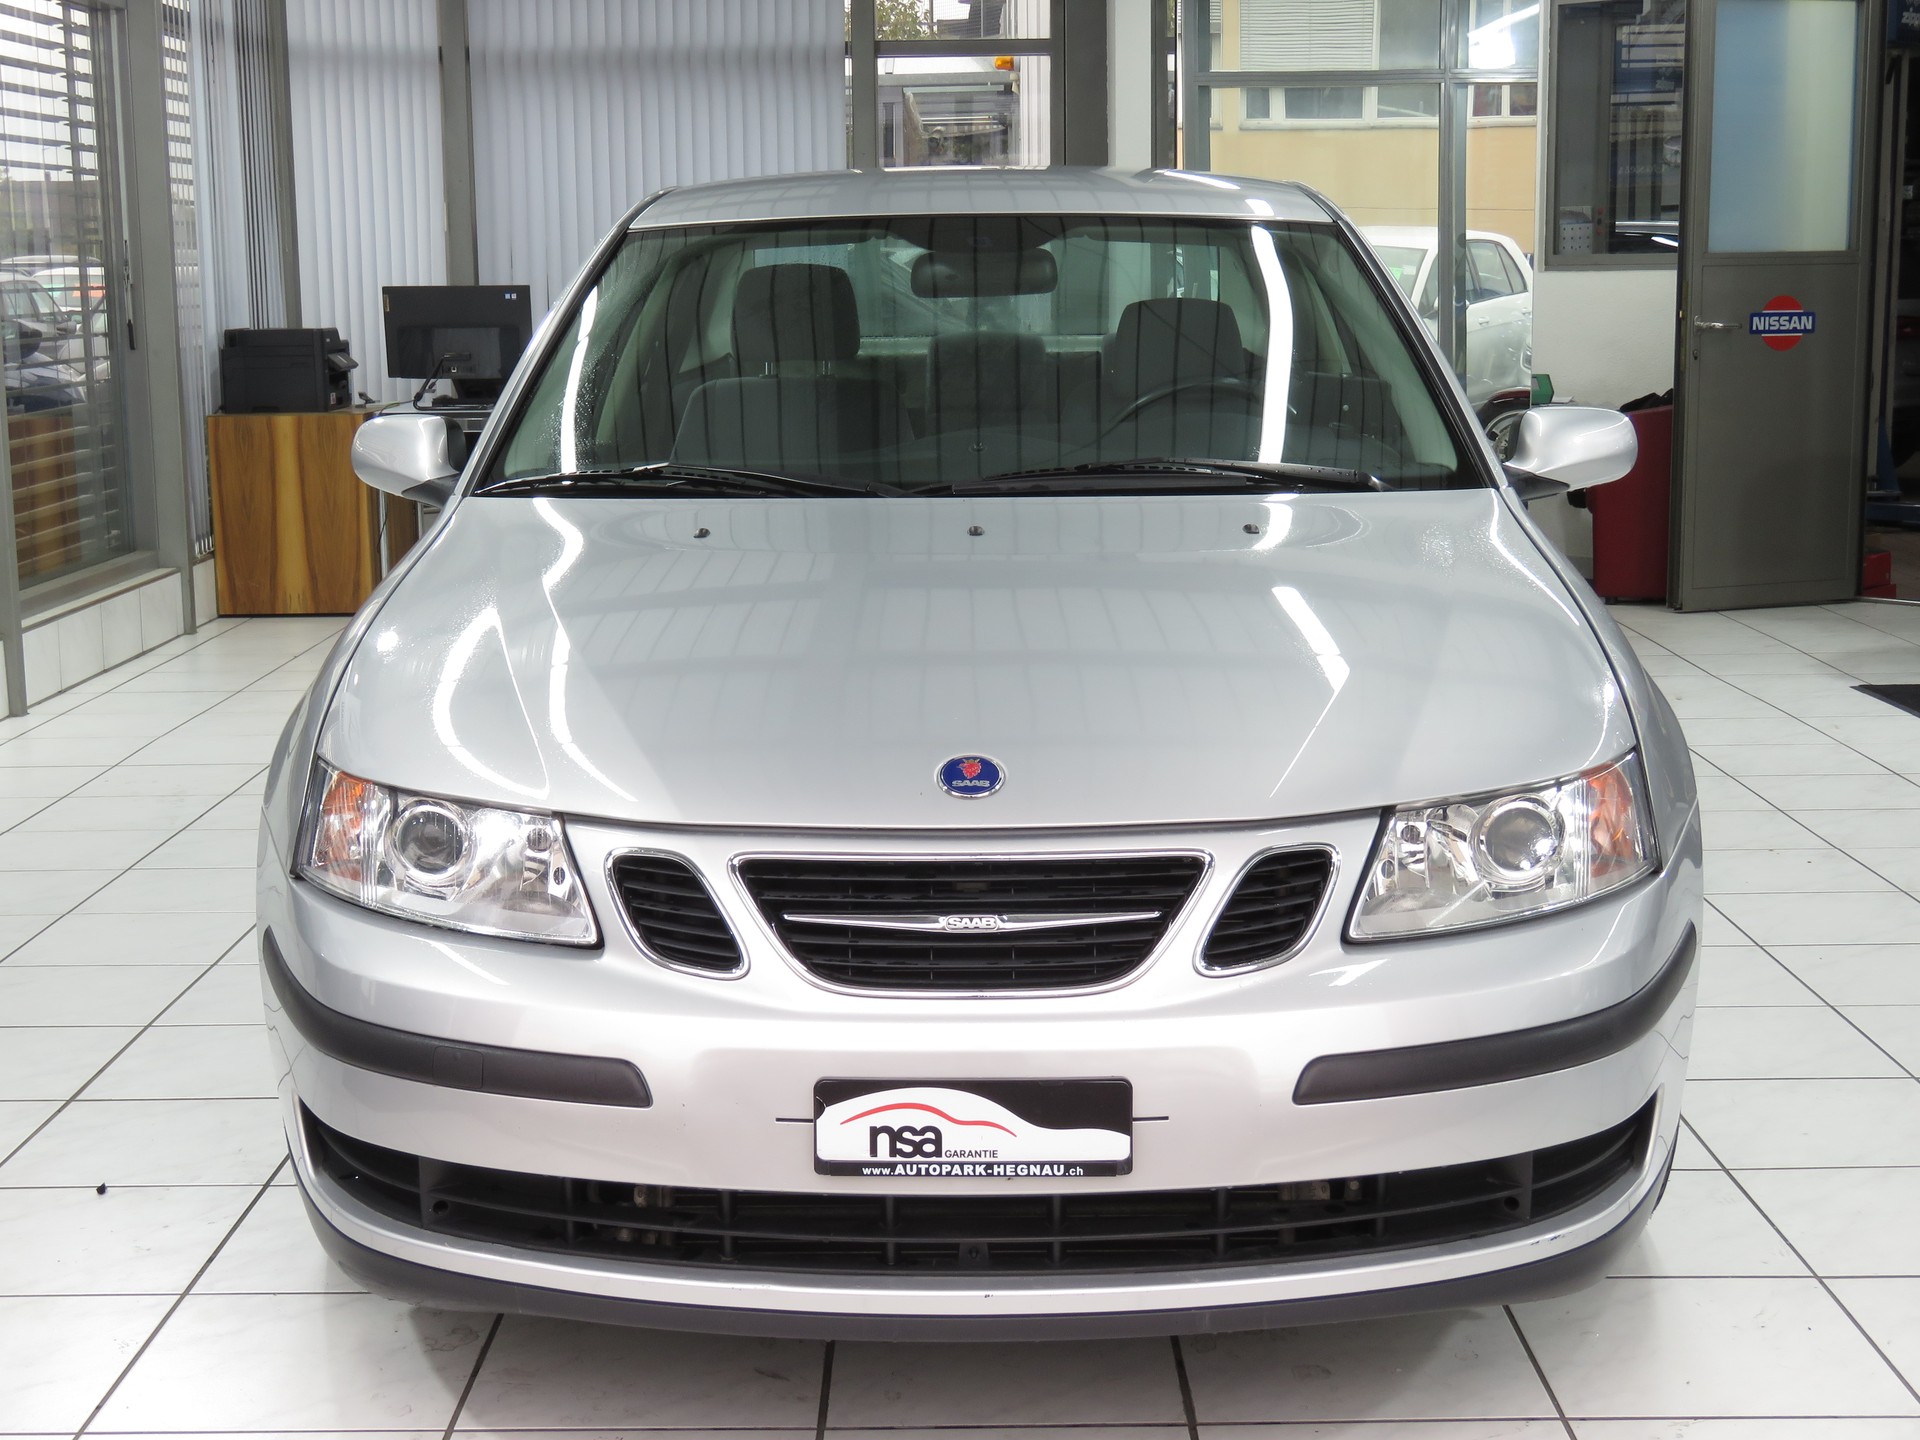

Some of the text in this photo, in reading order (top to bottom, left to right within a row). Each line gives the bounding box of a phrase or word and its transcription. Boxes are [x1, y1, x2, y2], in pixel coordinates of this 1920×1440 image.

[1752, 315, 1813, 331] NISSAN
[951, 779, 991, 787] SAAB
[947, 916, 997, 929] SAAB
[869, 1125, 999, 1159] nsa GARANTIE
[862, 1163, 1084, 1176] www.AUTOPARK-HEGNAU.ch
